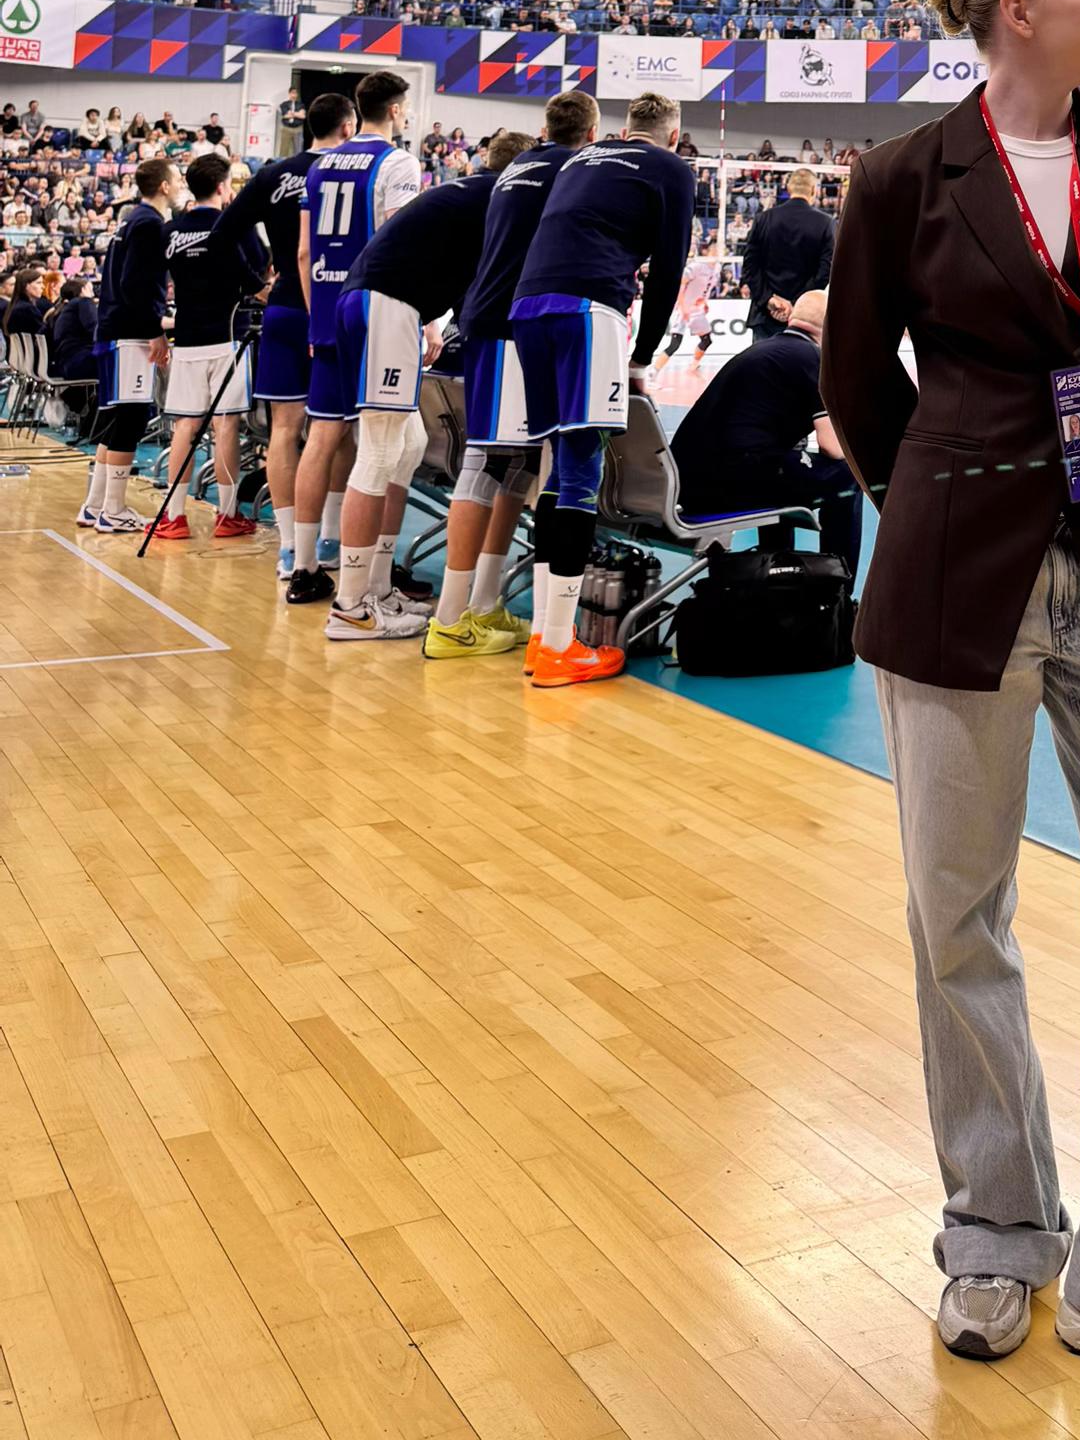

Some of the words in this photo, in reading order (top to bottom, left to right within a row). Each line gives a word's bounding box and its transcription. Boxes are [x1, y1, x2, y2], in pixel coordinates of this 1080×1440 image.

[318, 153, 375, 171] БОЧАРОВ
[316, 181, 356, 236] 11
[135, 374, 143, 388] 5
[383, 367, 402, 387] 16
